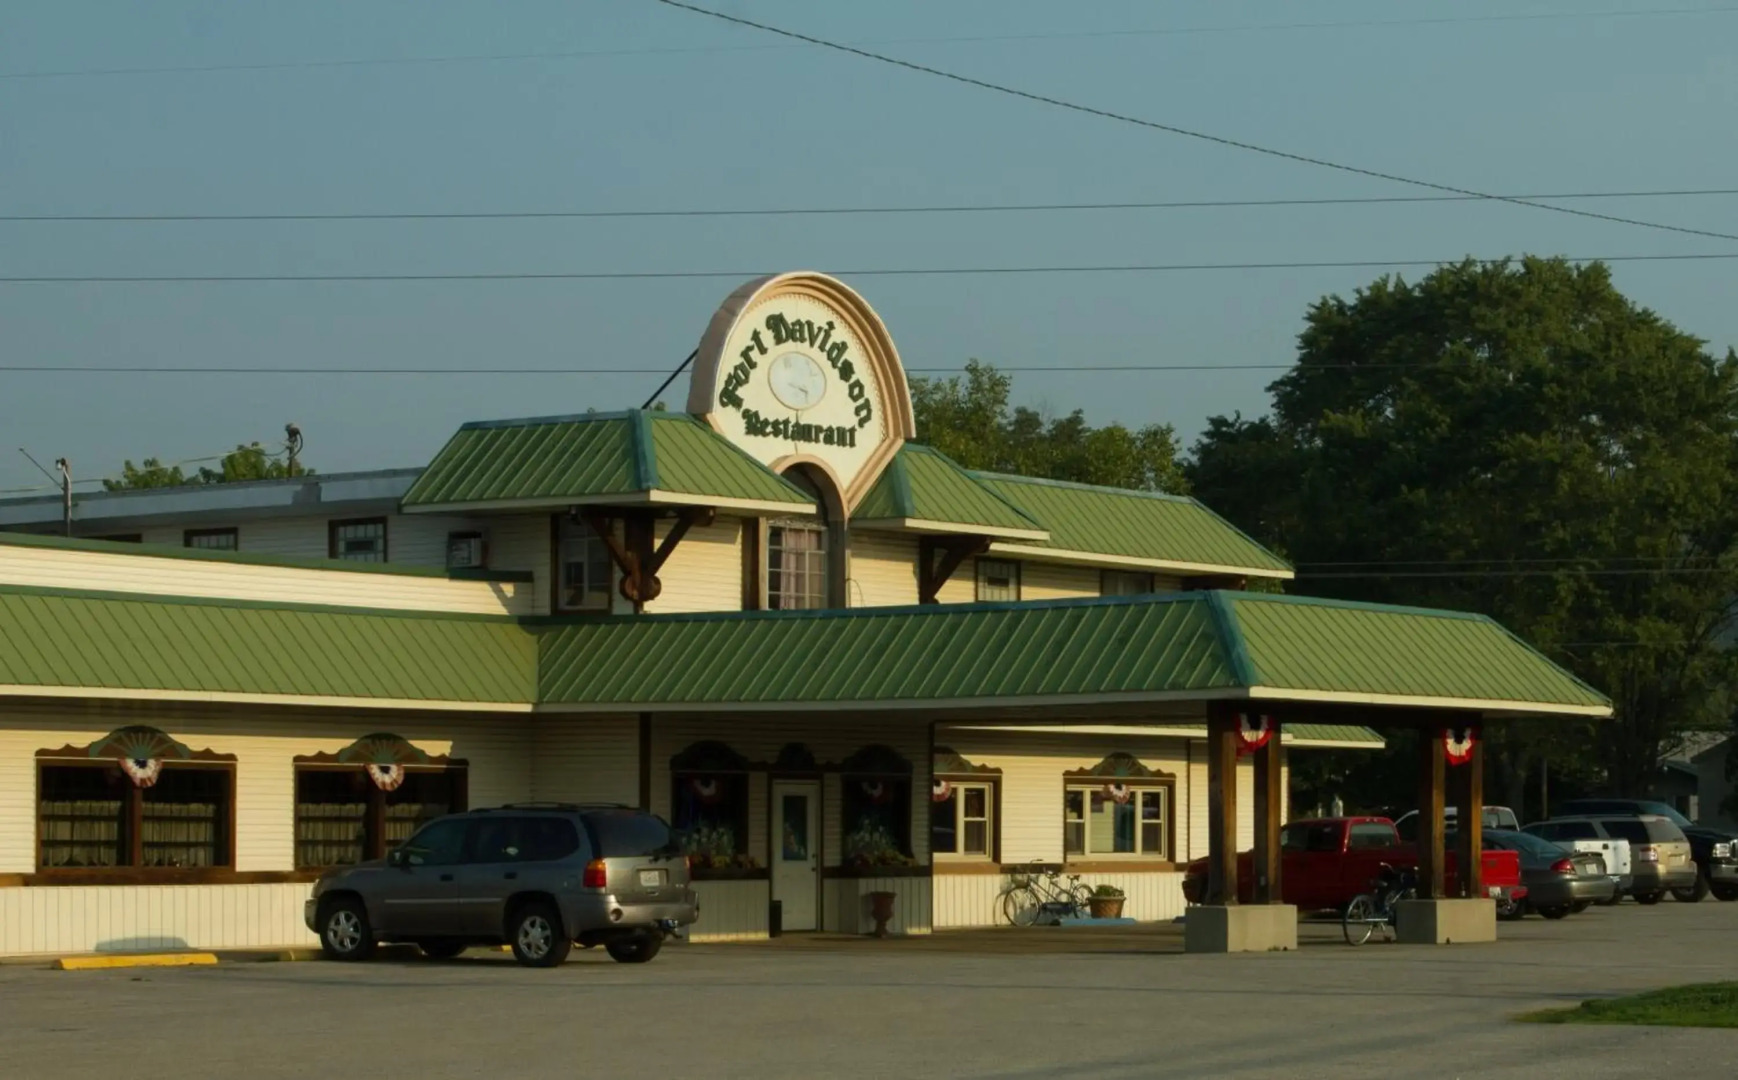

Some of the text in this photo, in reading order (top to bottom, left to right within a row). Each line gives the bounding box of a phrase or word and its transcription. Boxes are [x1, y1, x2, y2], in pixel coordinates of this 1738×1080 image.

[719, 312, 872, 428] Fort Davidson
[742, 408, 857, 448] Restaurant
